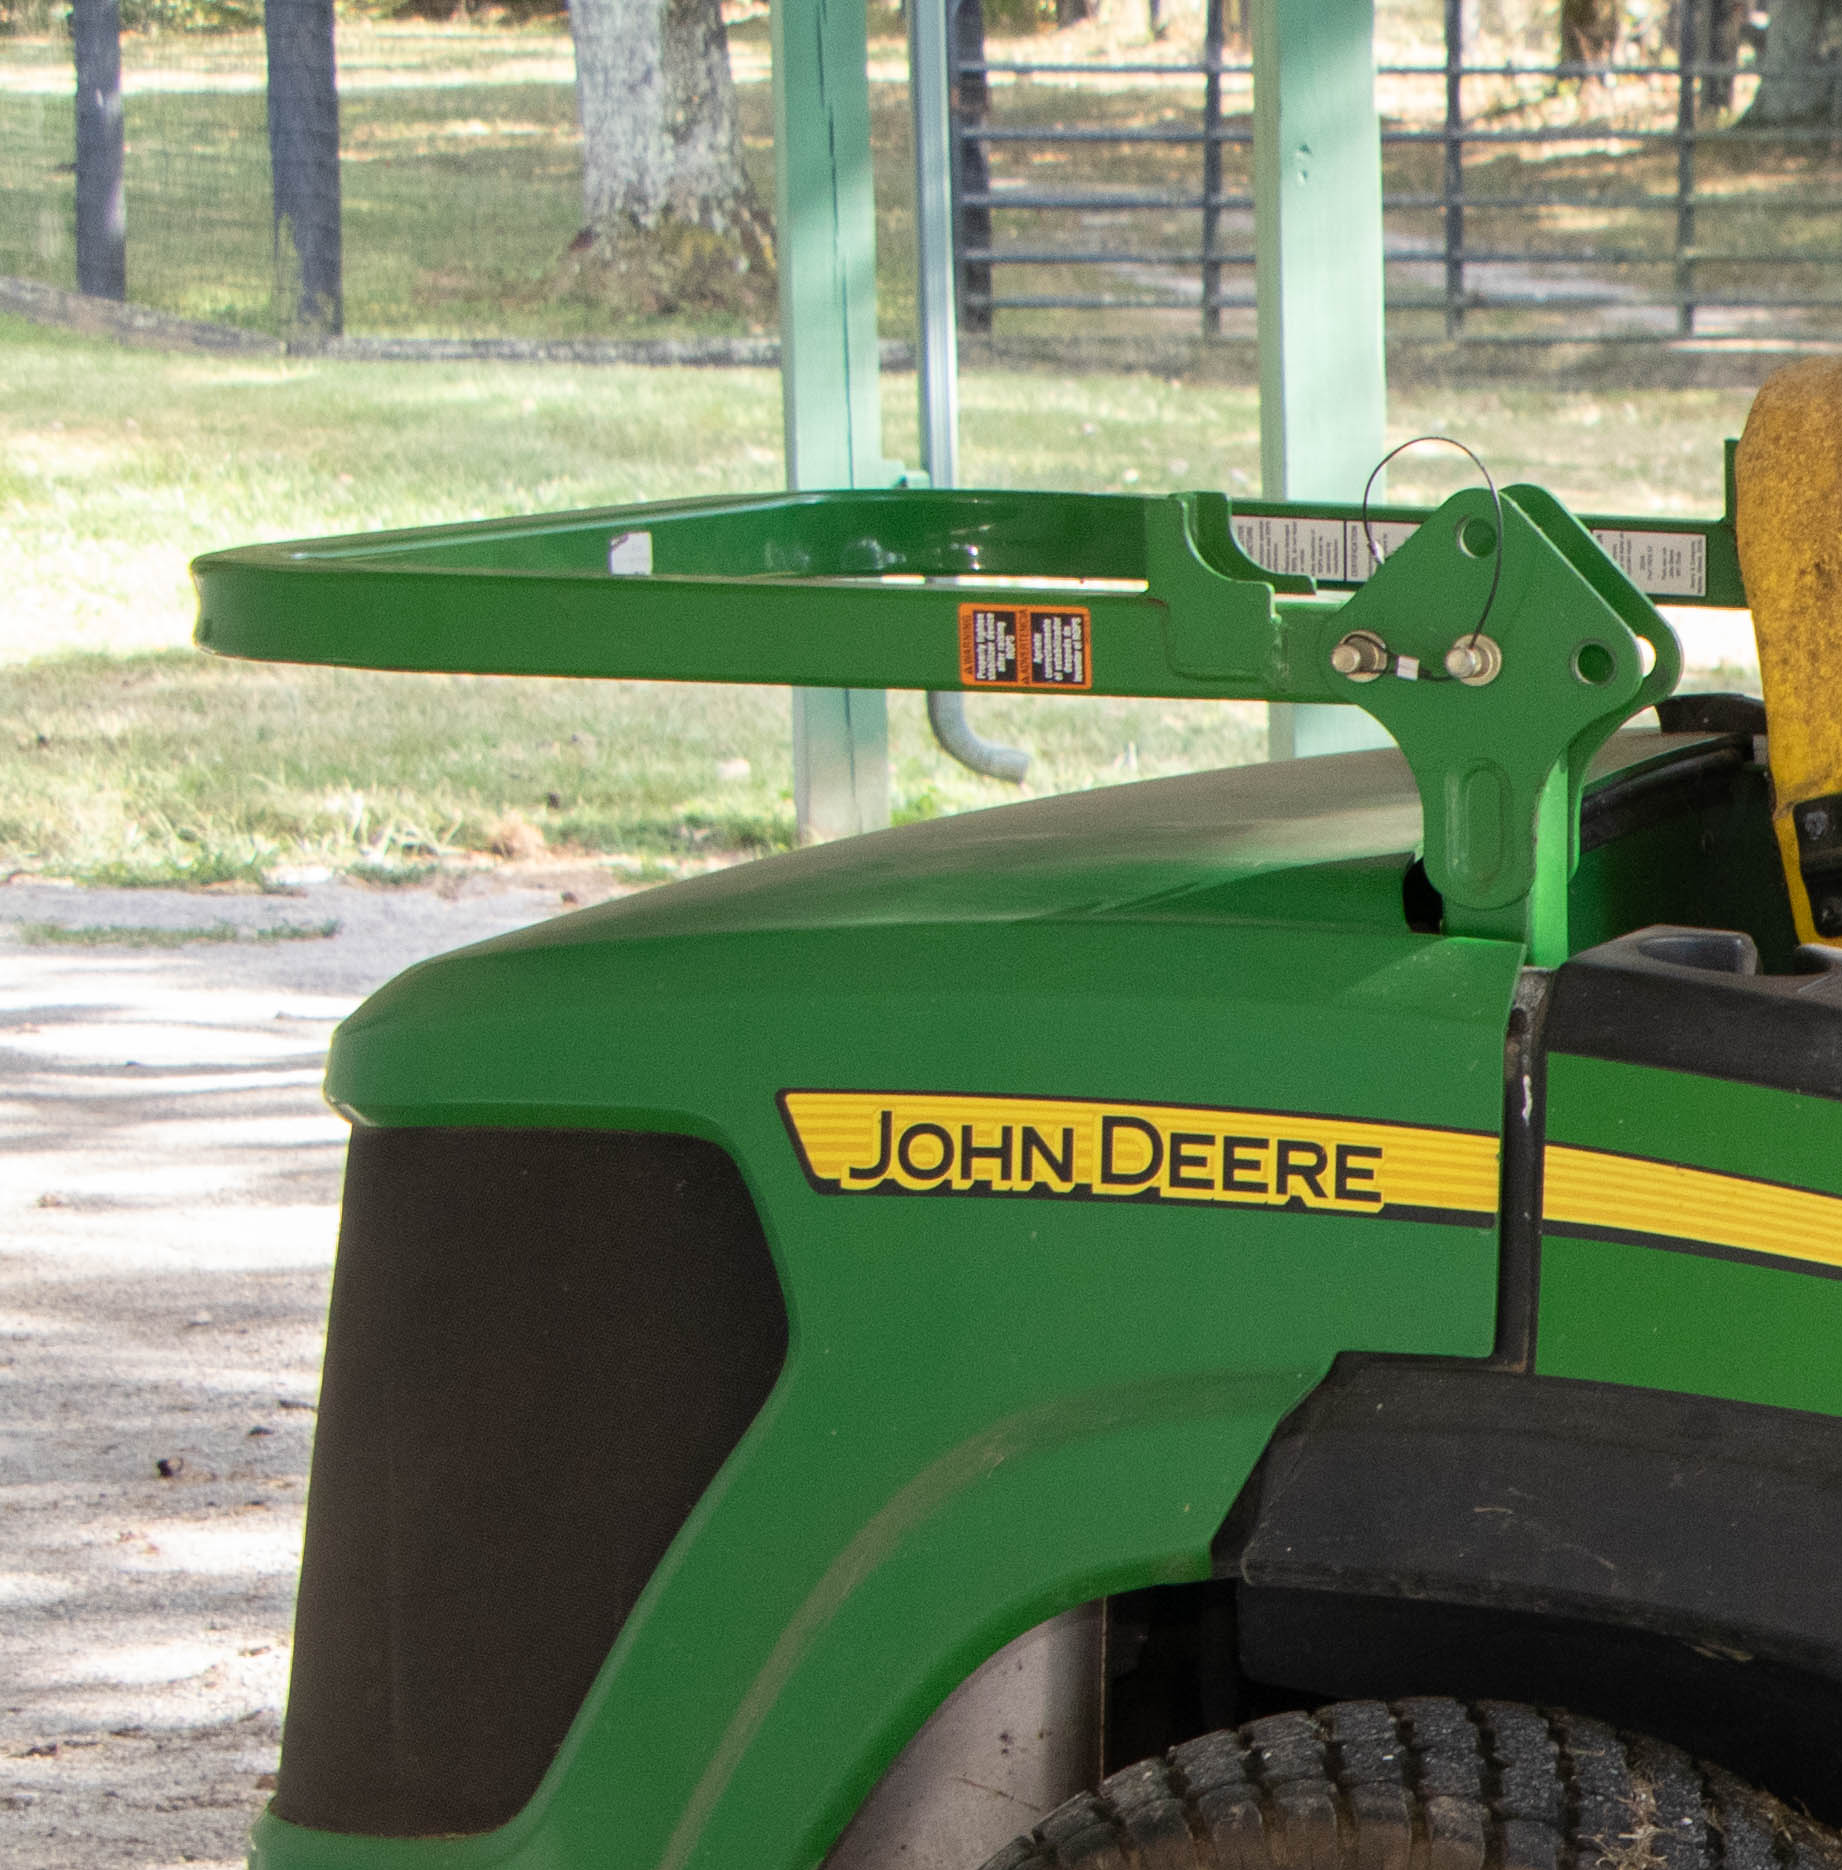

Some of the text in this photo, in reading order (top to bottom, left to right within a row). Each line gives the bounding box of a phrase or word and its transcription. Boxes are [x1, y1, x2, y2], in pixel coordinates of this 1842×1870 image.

[962, 616, 972, 664] WARNING
[850, 1110, 1385, 1203] JOHN DEERE
